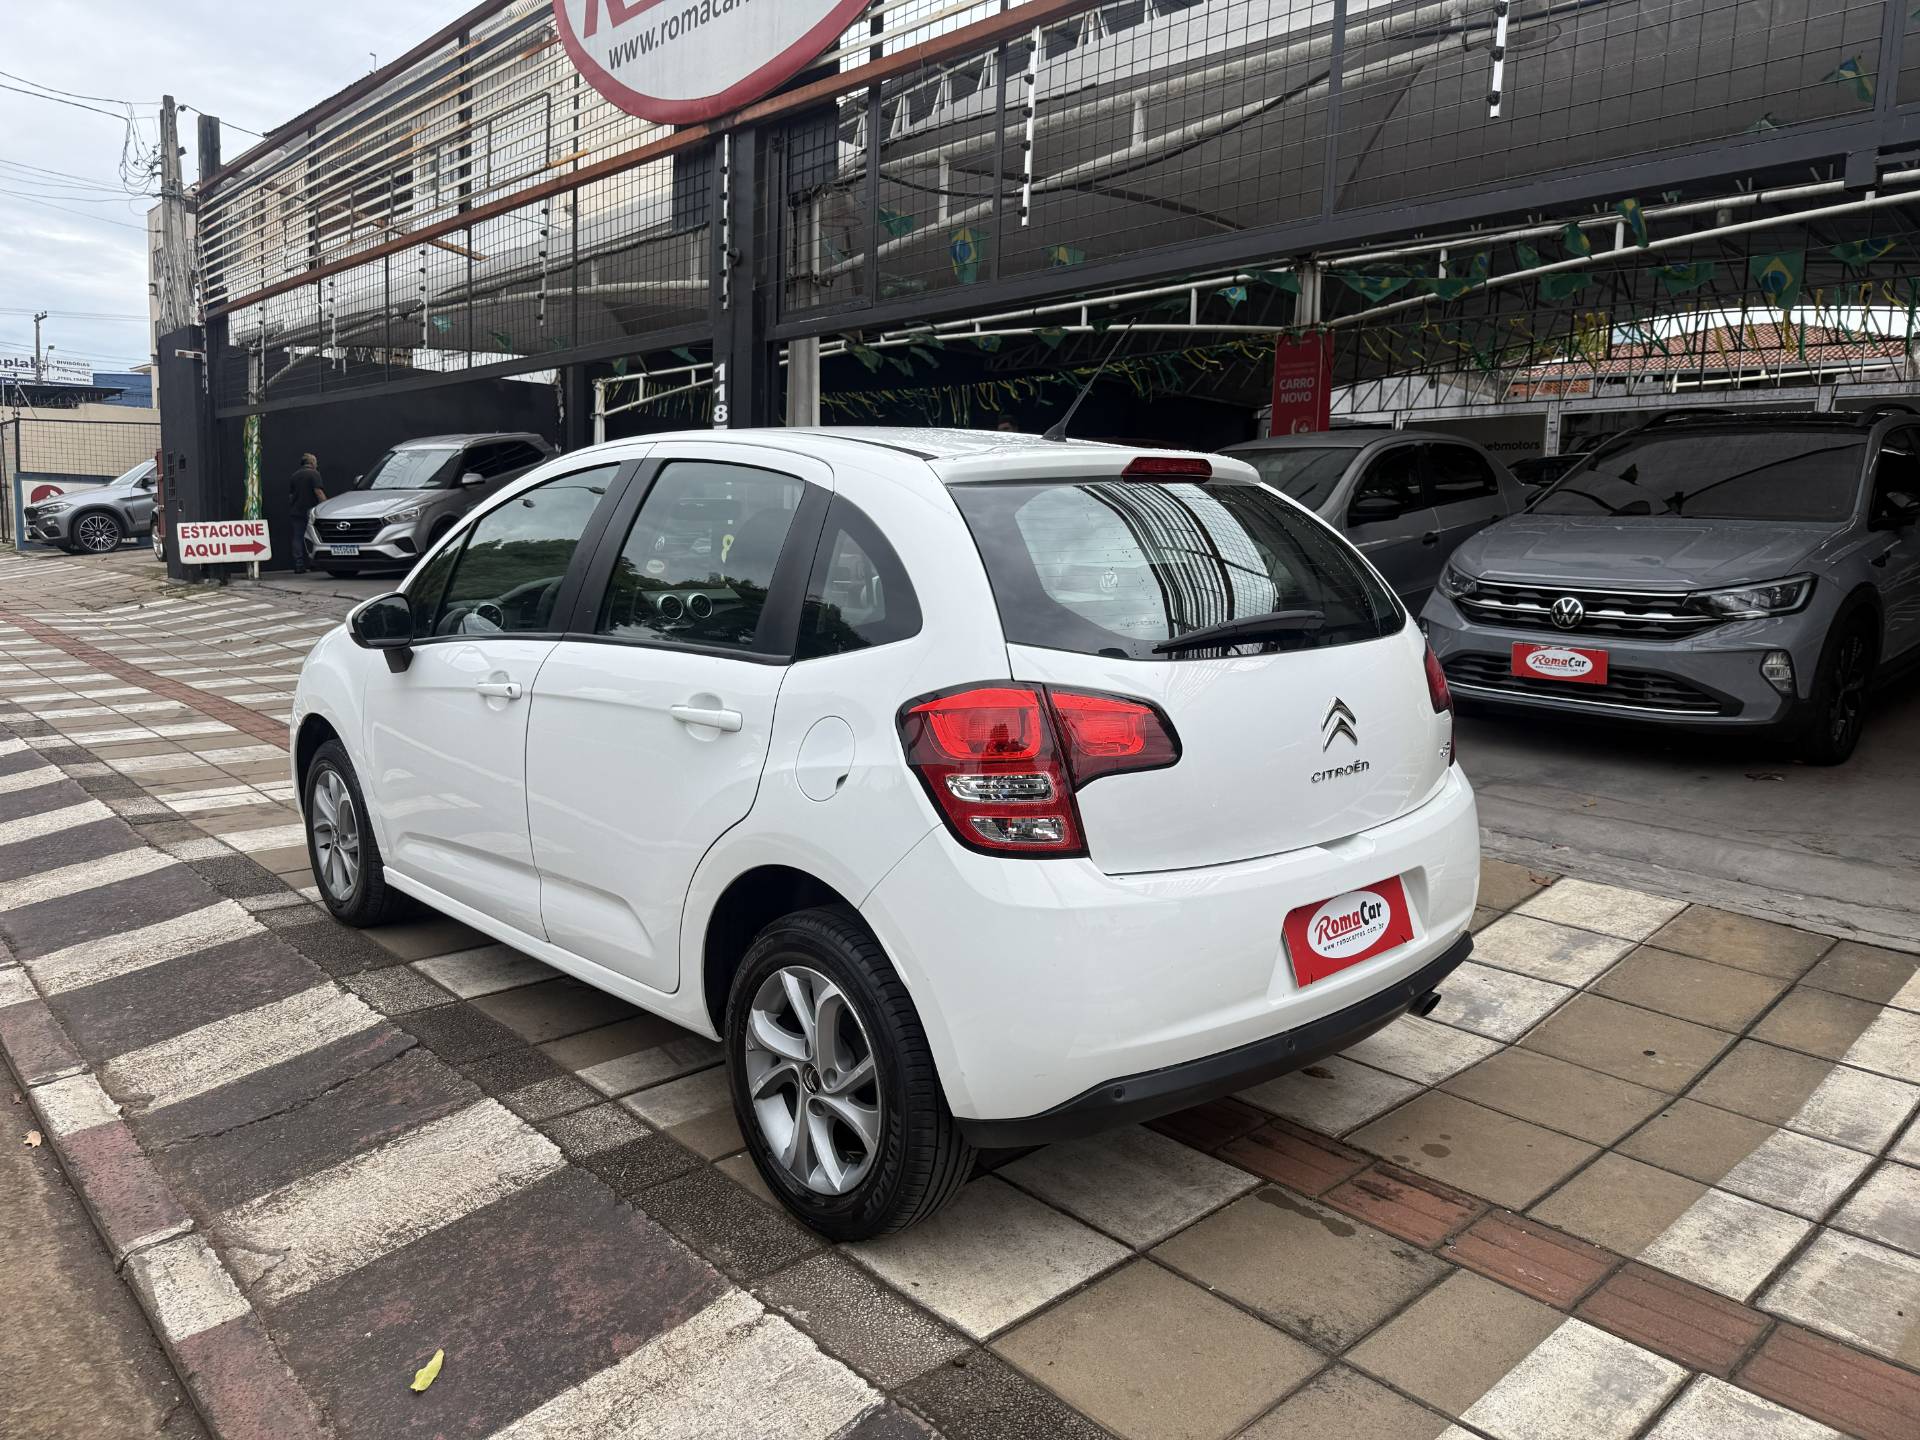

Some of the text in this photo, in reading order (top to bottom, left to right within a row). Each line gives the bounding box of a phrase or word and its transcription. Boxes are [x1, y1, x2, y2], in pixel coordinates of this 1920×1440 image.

[608, 0, 752, 70] www.romaca
[1279, 376, 1315, 391] CARRO
[713, 362, 729, 430] 118
[1280, 391, 1313, 405] NOVO
[181, 523, 264, 539] ESTACIONE
[184, 543, 227, 557] AQUI
[1314, 901, 1382, 945] RomaCar
